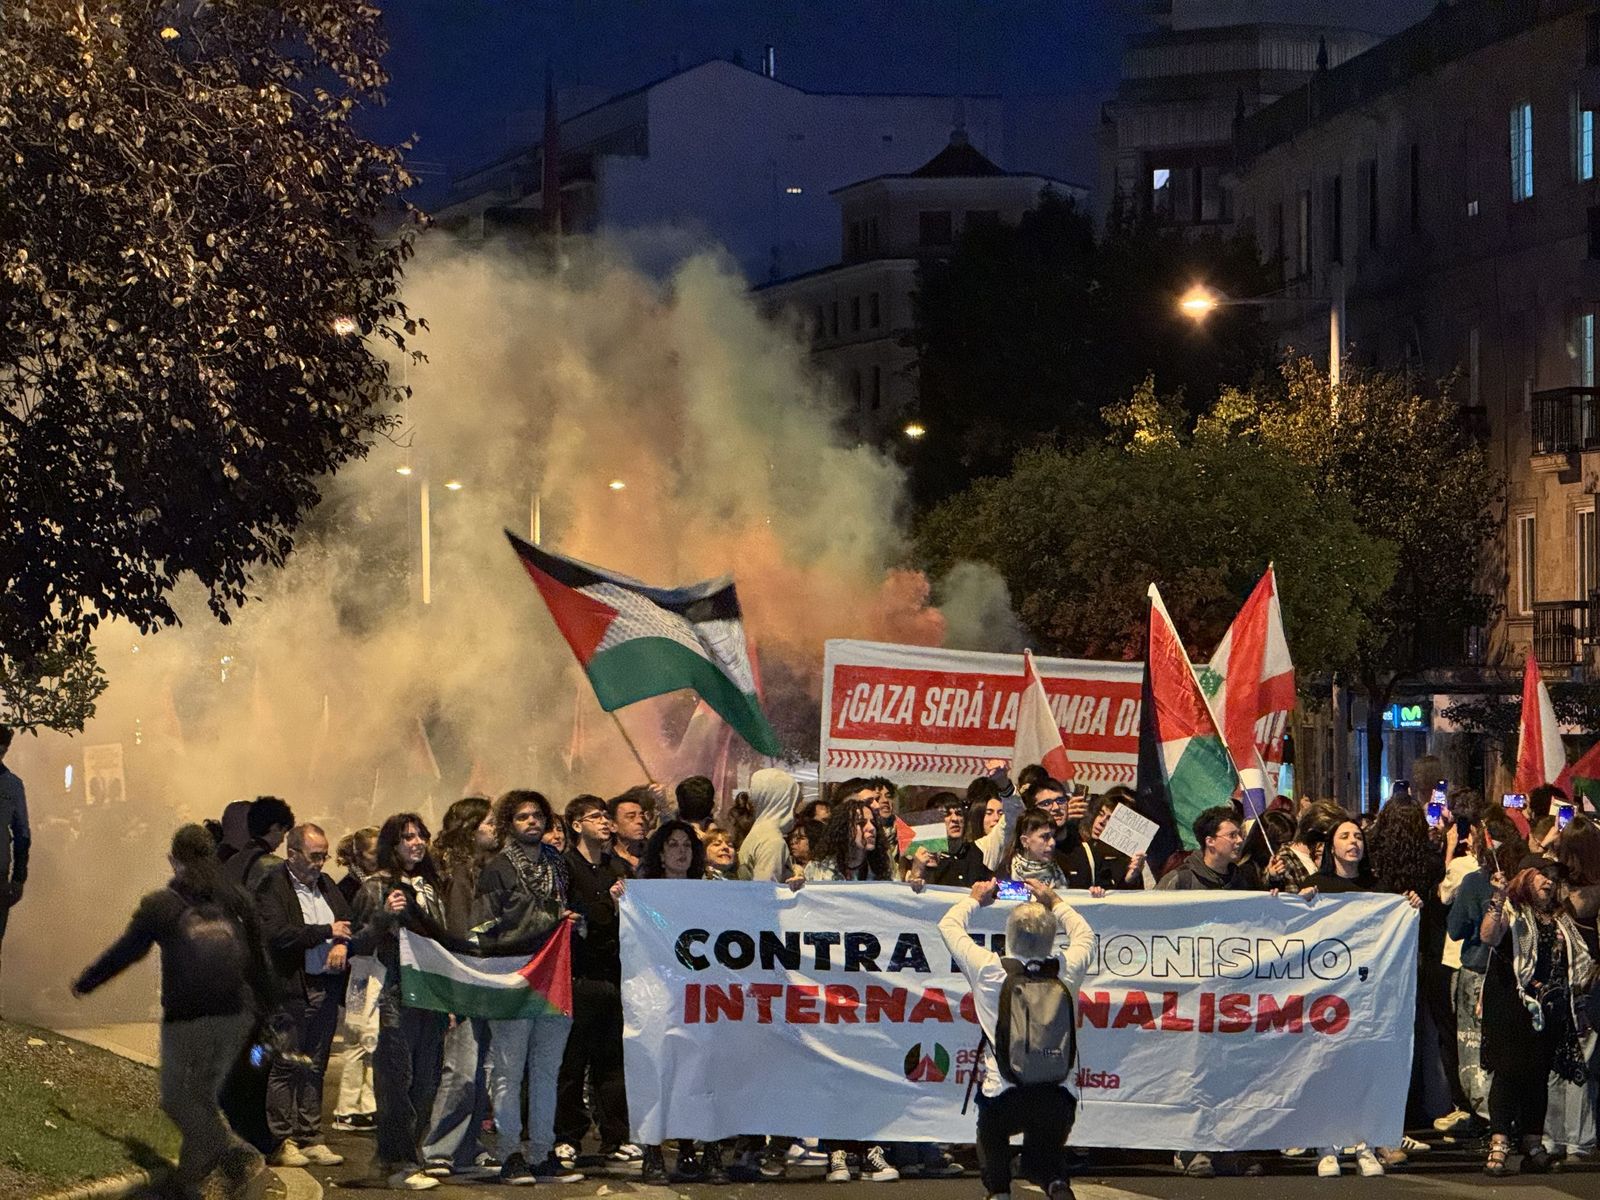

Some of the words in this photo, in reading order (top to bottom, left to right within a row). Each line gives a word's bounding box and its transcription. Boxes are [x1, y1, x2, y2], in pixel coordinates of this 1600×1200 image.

[837, 682, 916, 729] ¡GAZA
[920, 681, 985, 729] SERÁ
[988, 690, 1020, 731] LA
[1046, 693, 1111, 736] UMBA
[674, 928, 931, 973] CONTRA
[1056, 931, 1369, 982] ONISMO,
[683, 983, 1351, 1035] INTERNANALISMO
